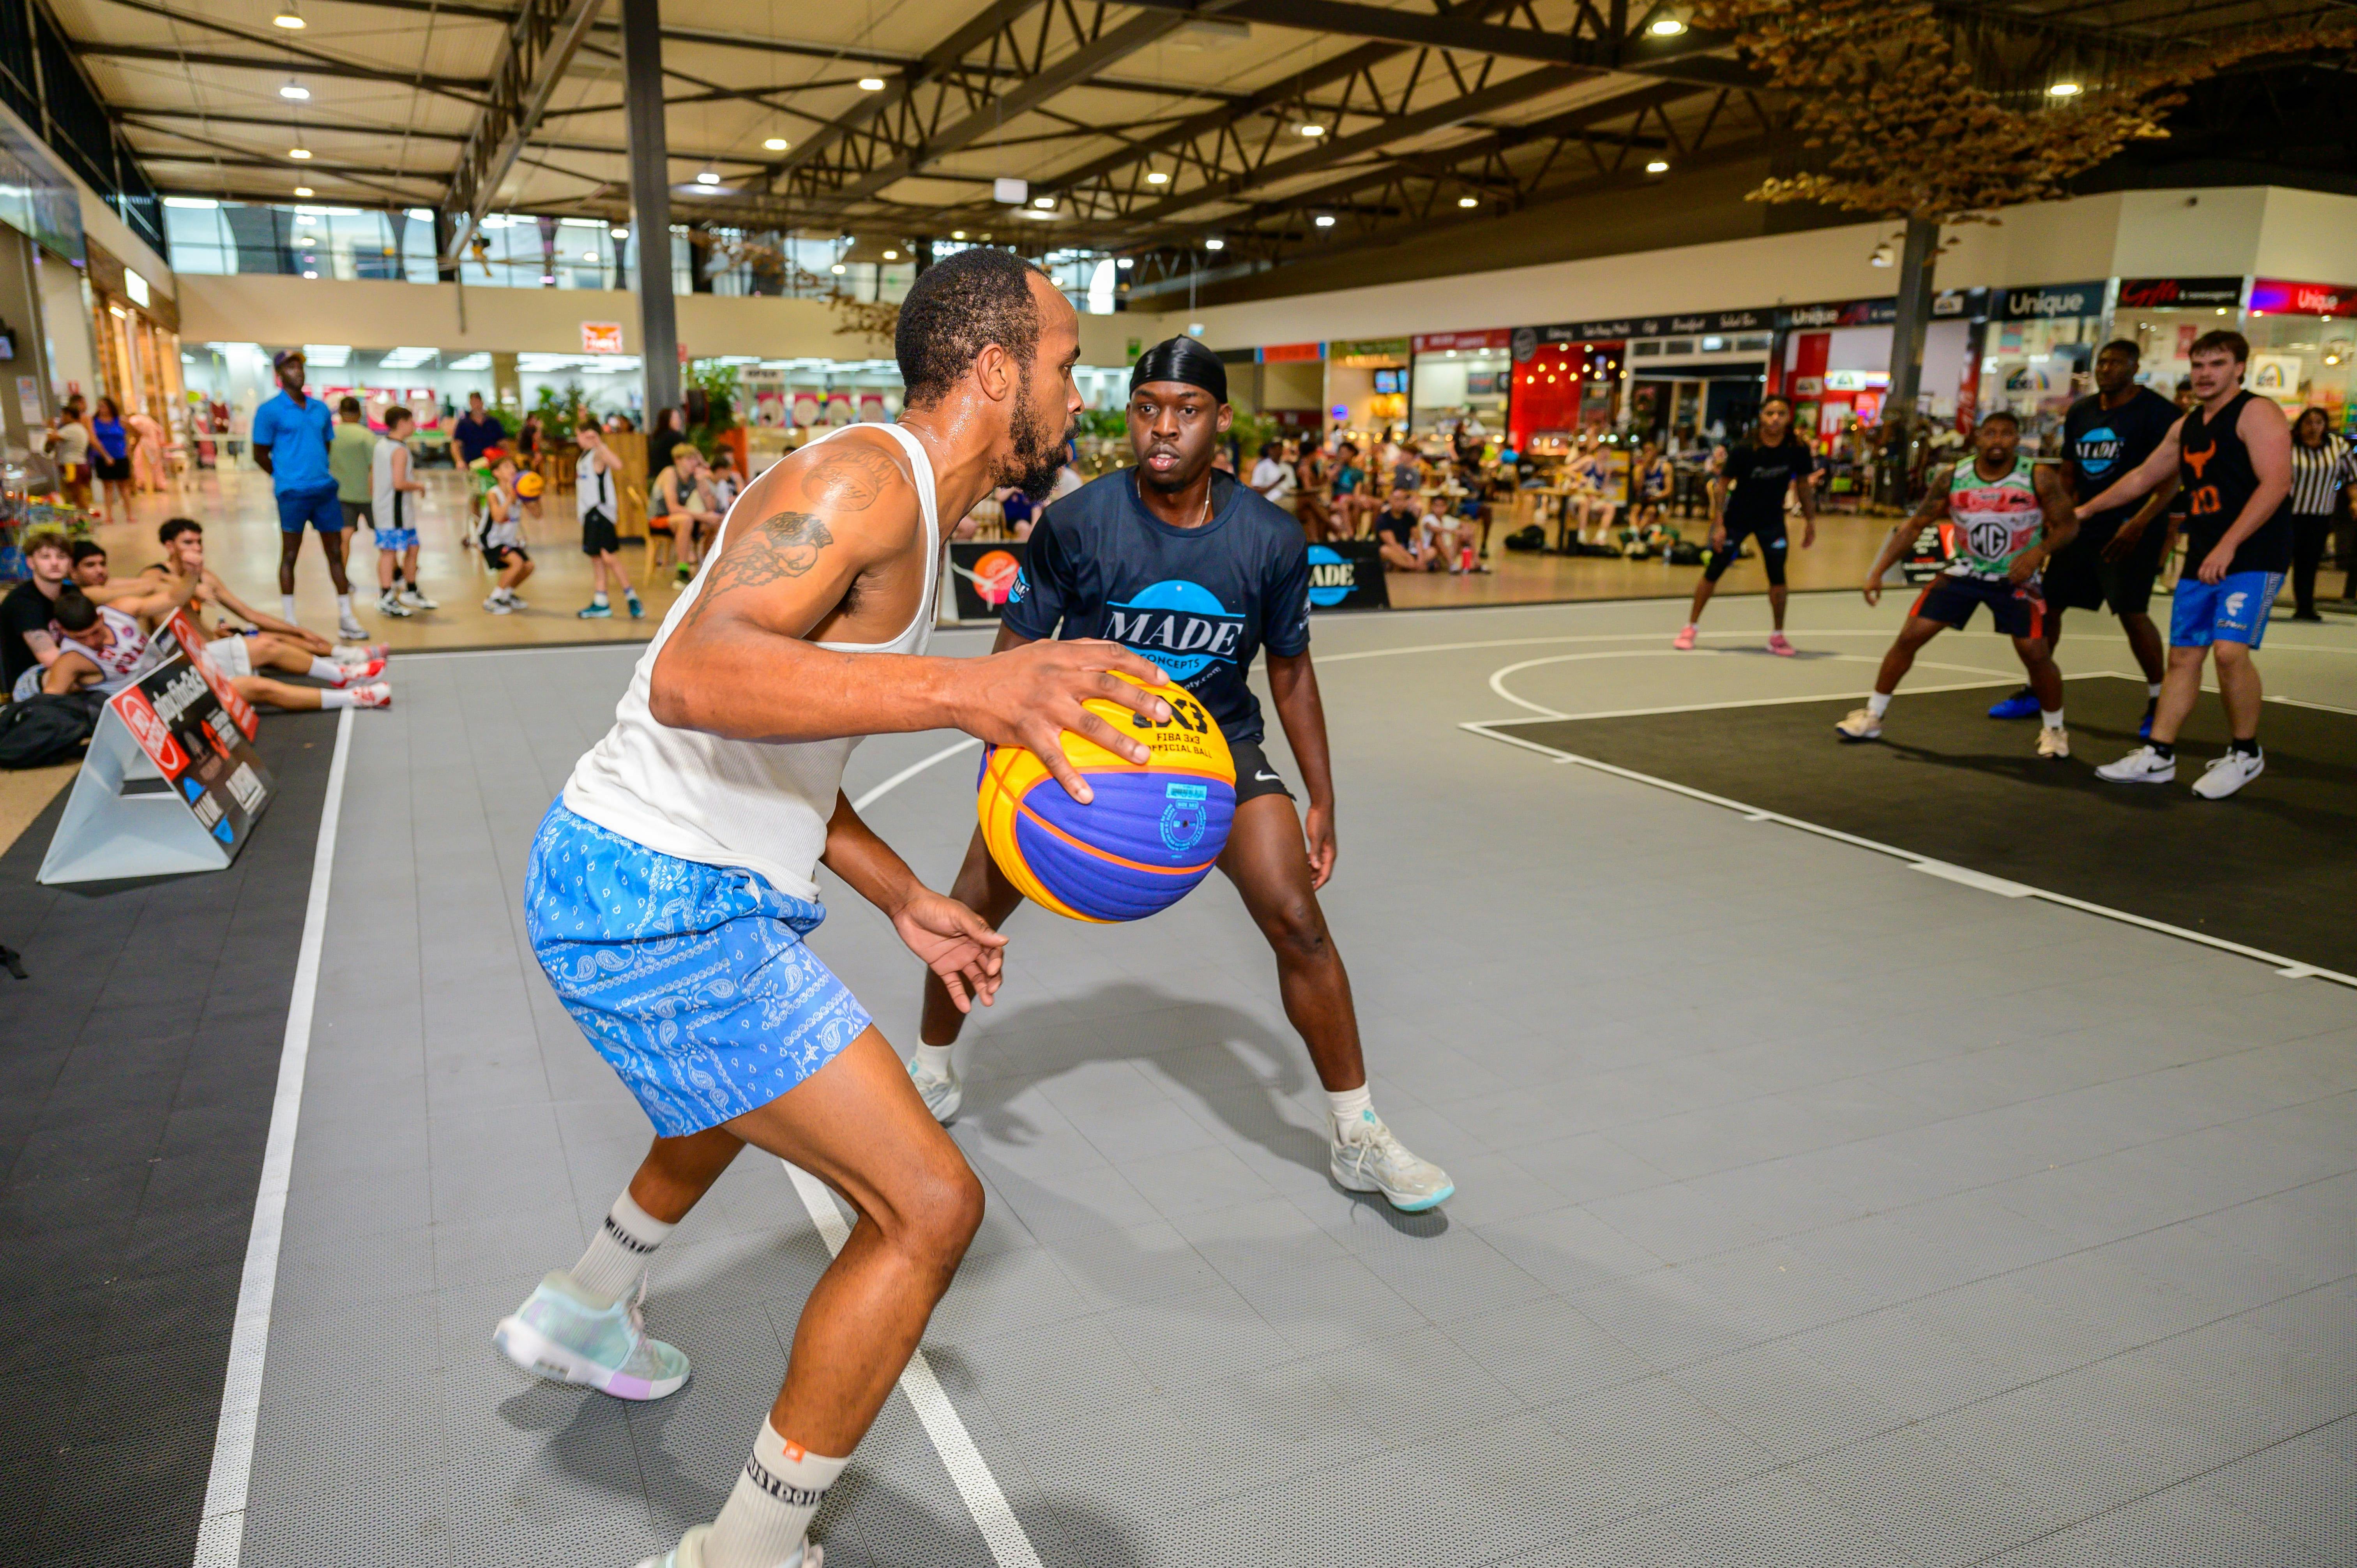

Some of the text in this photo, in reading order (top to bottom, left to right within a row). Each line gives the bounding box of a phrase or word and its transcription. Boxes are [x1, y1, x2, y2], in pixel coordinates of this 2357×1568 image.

[2009, 291, 2084, 318] Unique
[2297, 289, 2338, 314] Unique
[2191, 486, 2220, 515] 10
[1973, 525, 2005, 557] MG
[1309, 564, 1354, 587] ADE
[1102, 611, 1244, 655] MADE
[1184, 735, 1200, 744] 3x3
[1194, 747, 1212, 758] BALL
